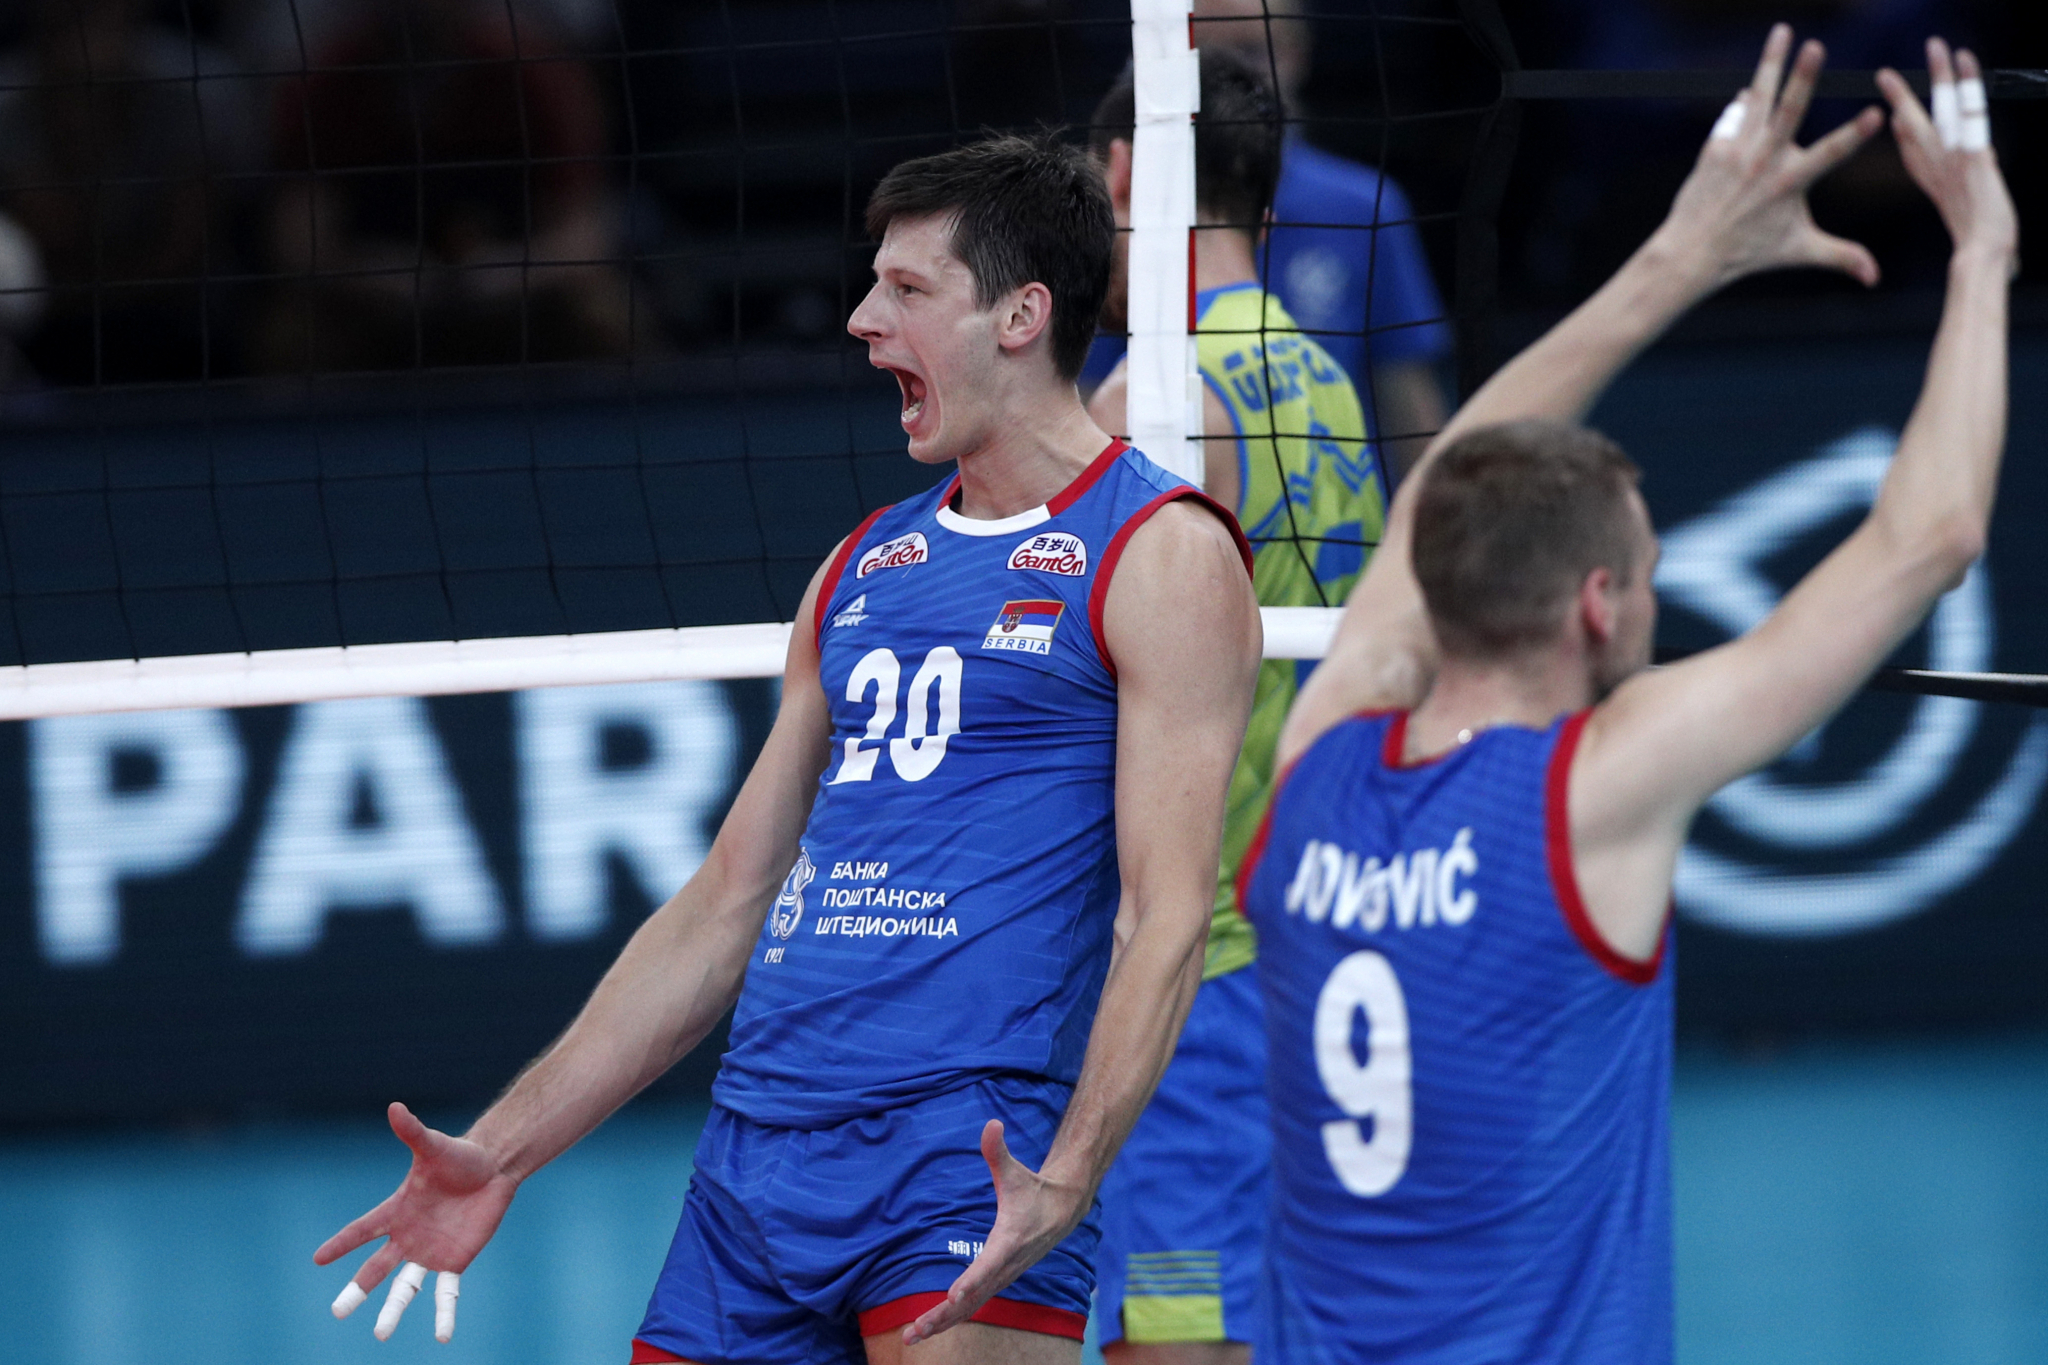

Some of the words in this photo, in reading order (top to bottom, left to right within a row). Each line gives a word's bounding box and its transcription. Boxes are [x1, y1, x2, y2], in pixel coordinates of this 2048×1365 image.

[1032, 537, 1078, 553] 百岁山
[985, 638, 1047, 653] SERBIA
[826, 647, 963, 786] 20
[28, 676, 783, 966] PAR
[830, 861, 889, 880] БАНКА
[822, 887, 946, 910] ПОШТАНСКА
[815, 916, 959, 939] ШТЕДИОНИЦА
[1314, 950, 1414, 1197] 9
